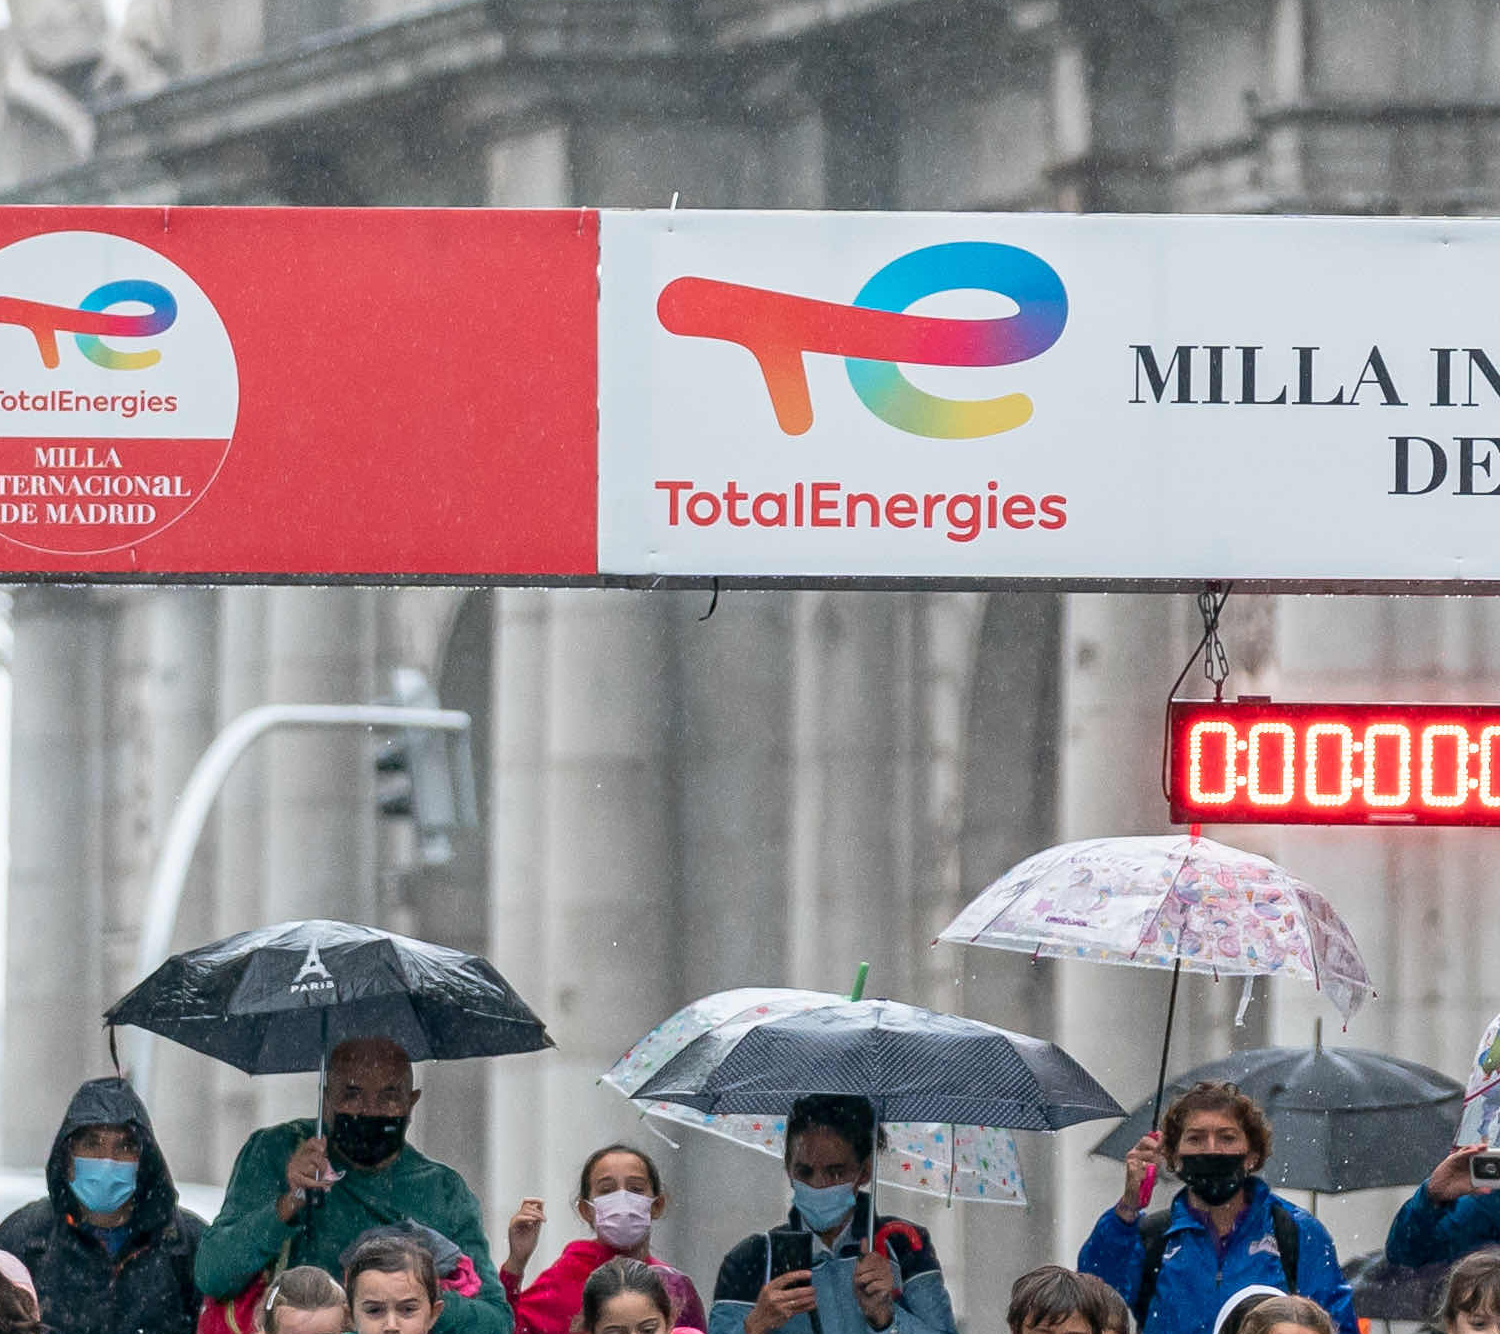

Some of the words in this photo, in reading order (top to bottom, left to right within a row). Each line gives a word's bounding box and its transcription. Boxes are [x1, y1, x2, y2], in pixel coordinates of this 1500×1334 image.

[1129, 345, 1408, 408] MILLA
[35, 447, 122, 468] MILLA
[0, 503, 37, 524] DE
[46, 503, 156, 525] MADRID
[654, 480, 1067, 543] TotalEnergies
